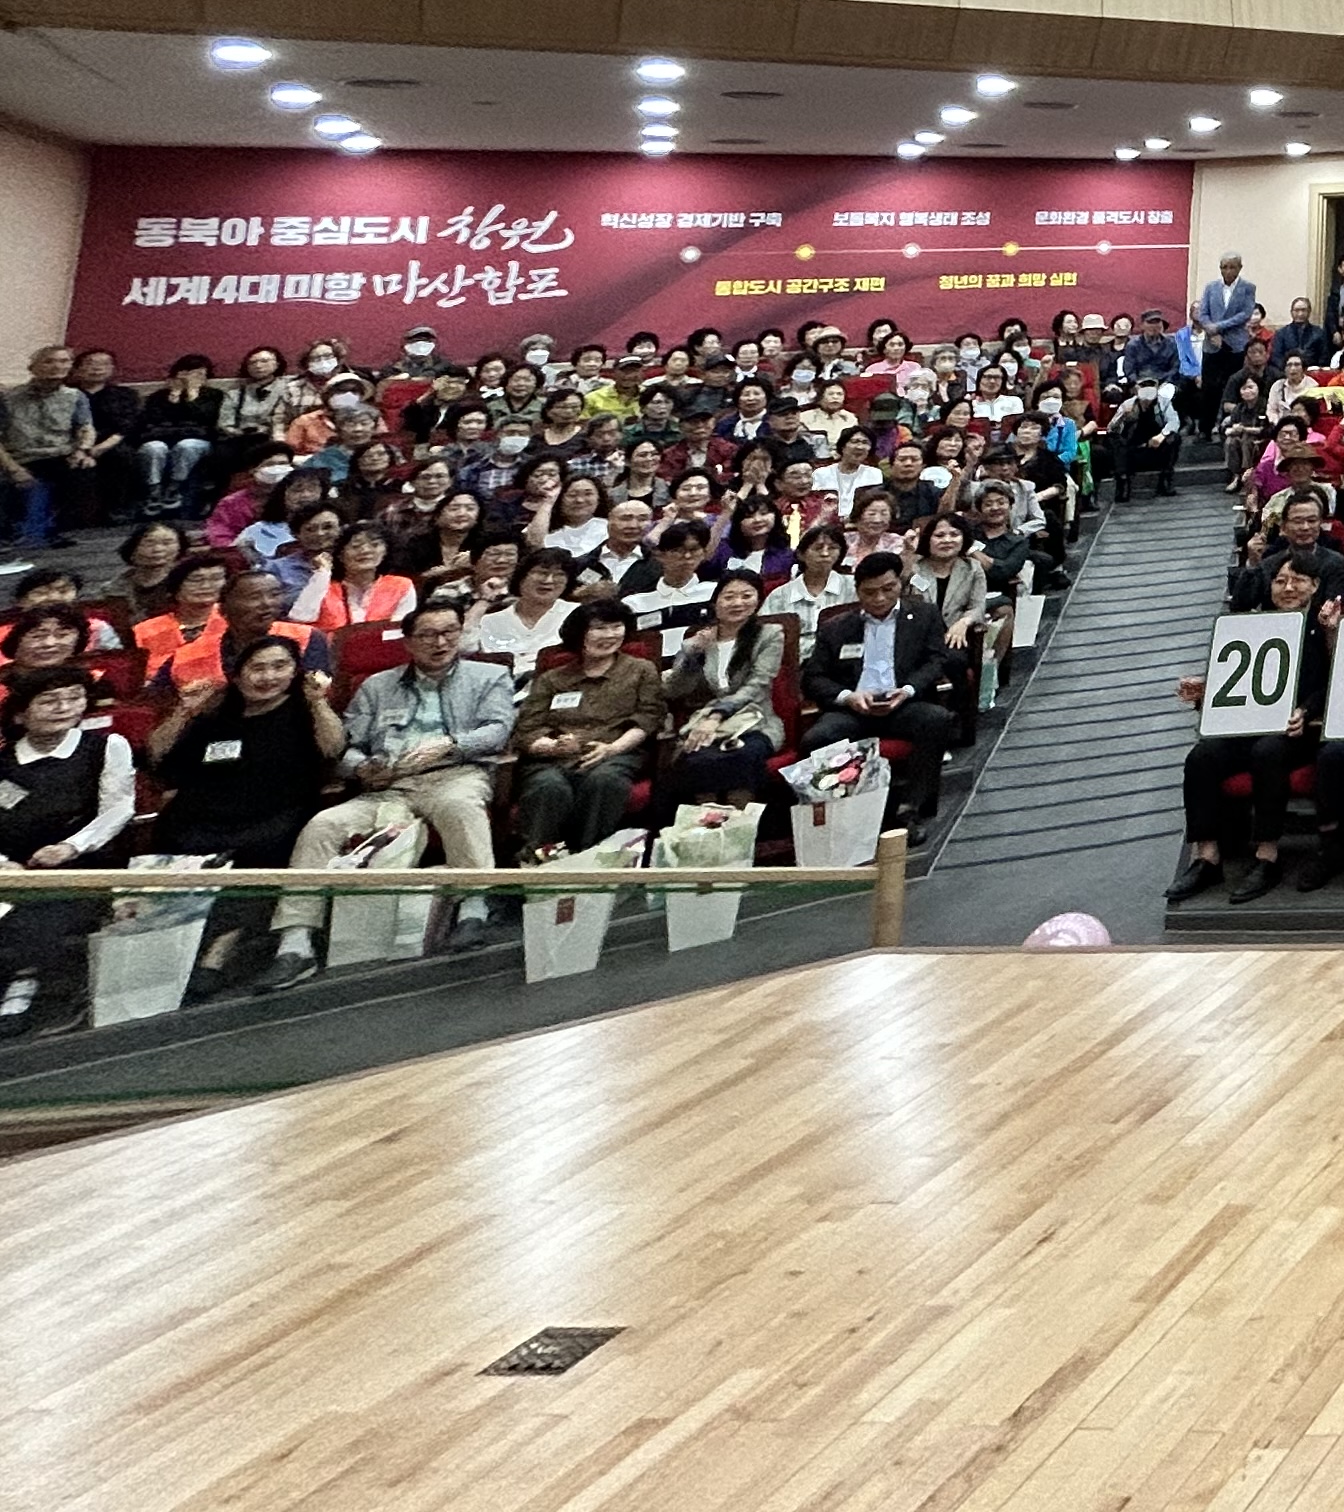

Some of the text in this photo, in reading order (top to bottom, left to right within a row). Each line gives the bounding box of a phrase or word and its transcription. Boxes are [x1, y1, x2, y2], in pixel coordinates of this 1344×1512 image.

[134, 203, 575, 254] 동북아 중심도시 창원
[960, 211, 992, 226] 조성
[371, 259, 569, 308] 마산합포
[786, 278, 850, 295] 공간구조
